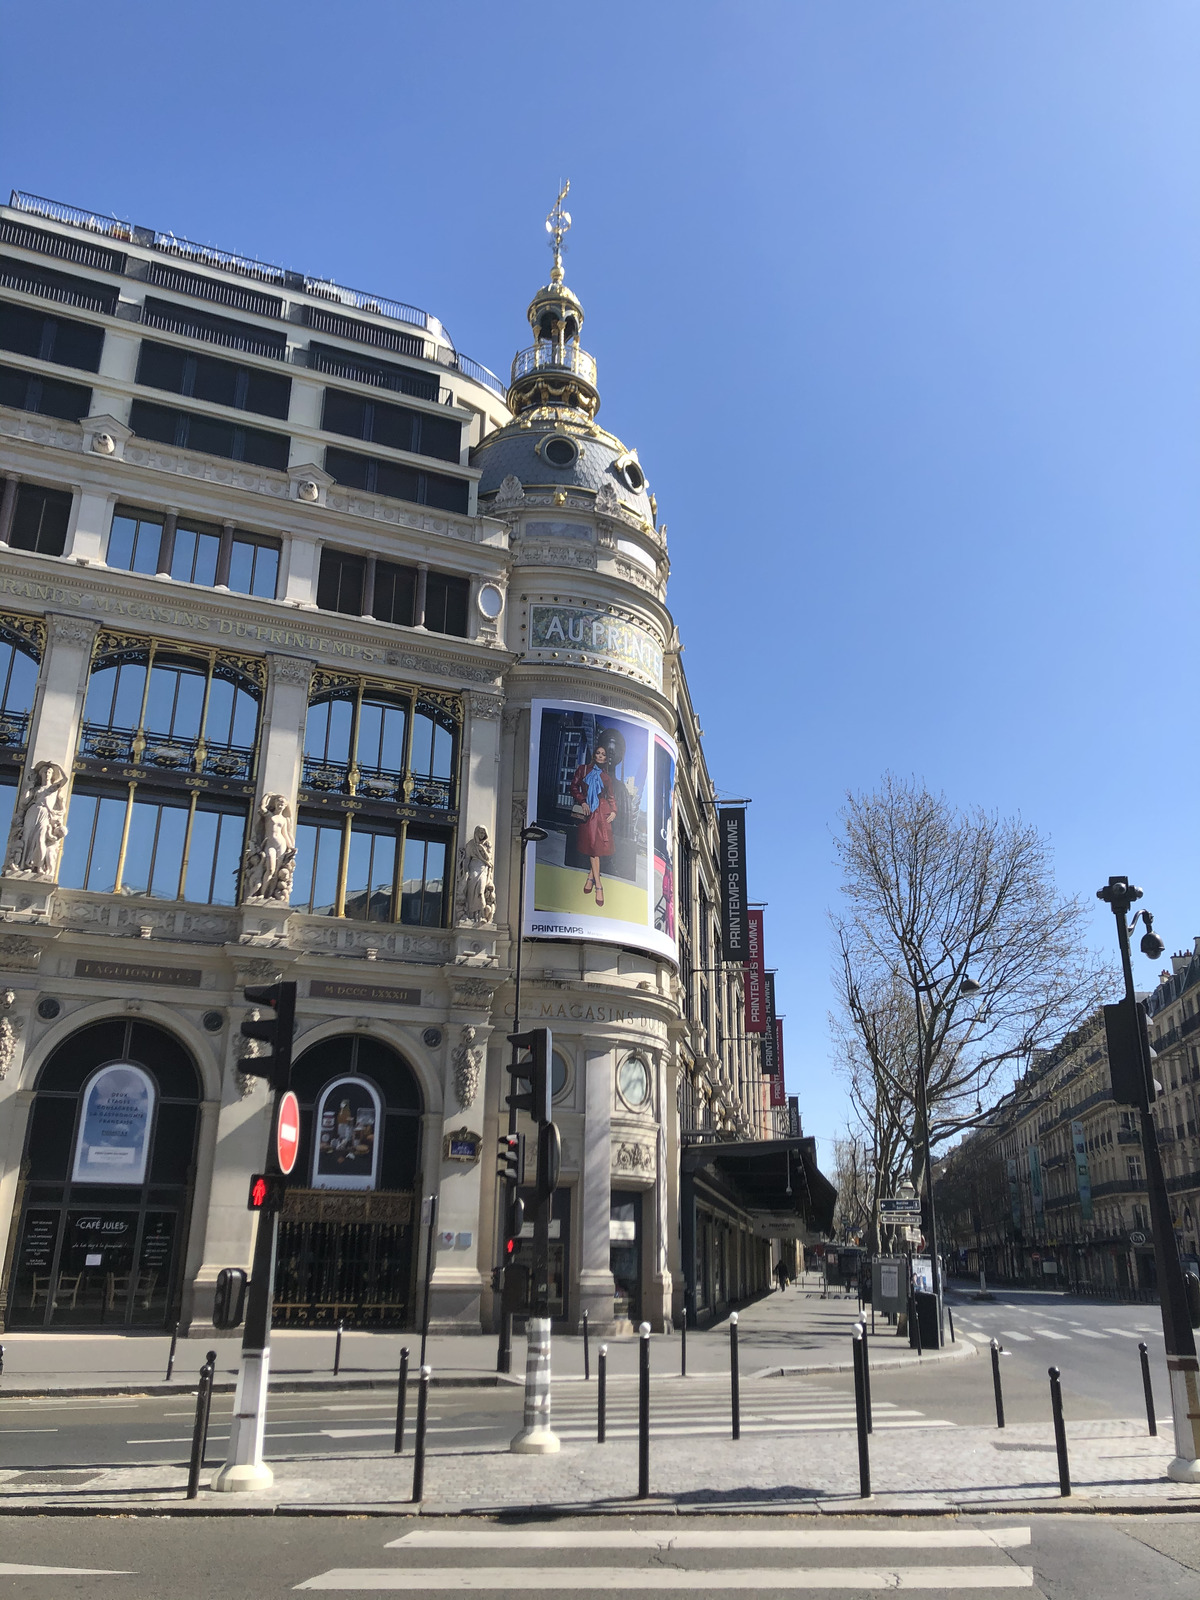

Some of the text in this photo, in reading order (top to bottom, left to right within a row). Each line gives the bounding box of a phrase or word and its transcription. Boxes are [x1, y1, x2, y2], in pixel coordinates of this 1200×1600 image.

[1, 577, 375, 661] RANDS MAGASINS DU PRINTEMPS
[545, 615, 660, 678] AU PRINTE
[727, 819, 741, 949] PRINTEMPS HOMME
[531, 924, 584, 935] PRINTEMPS
[749, 919, 760, 1023] PRINTEMPS HOMME
[540, 1003, 634, 1025] MAGASINS
[80, 1220, 124, 1229] CAFÉ JULES
